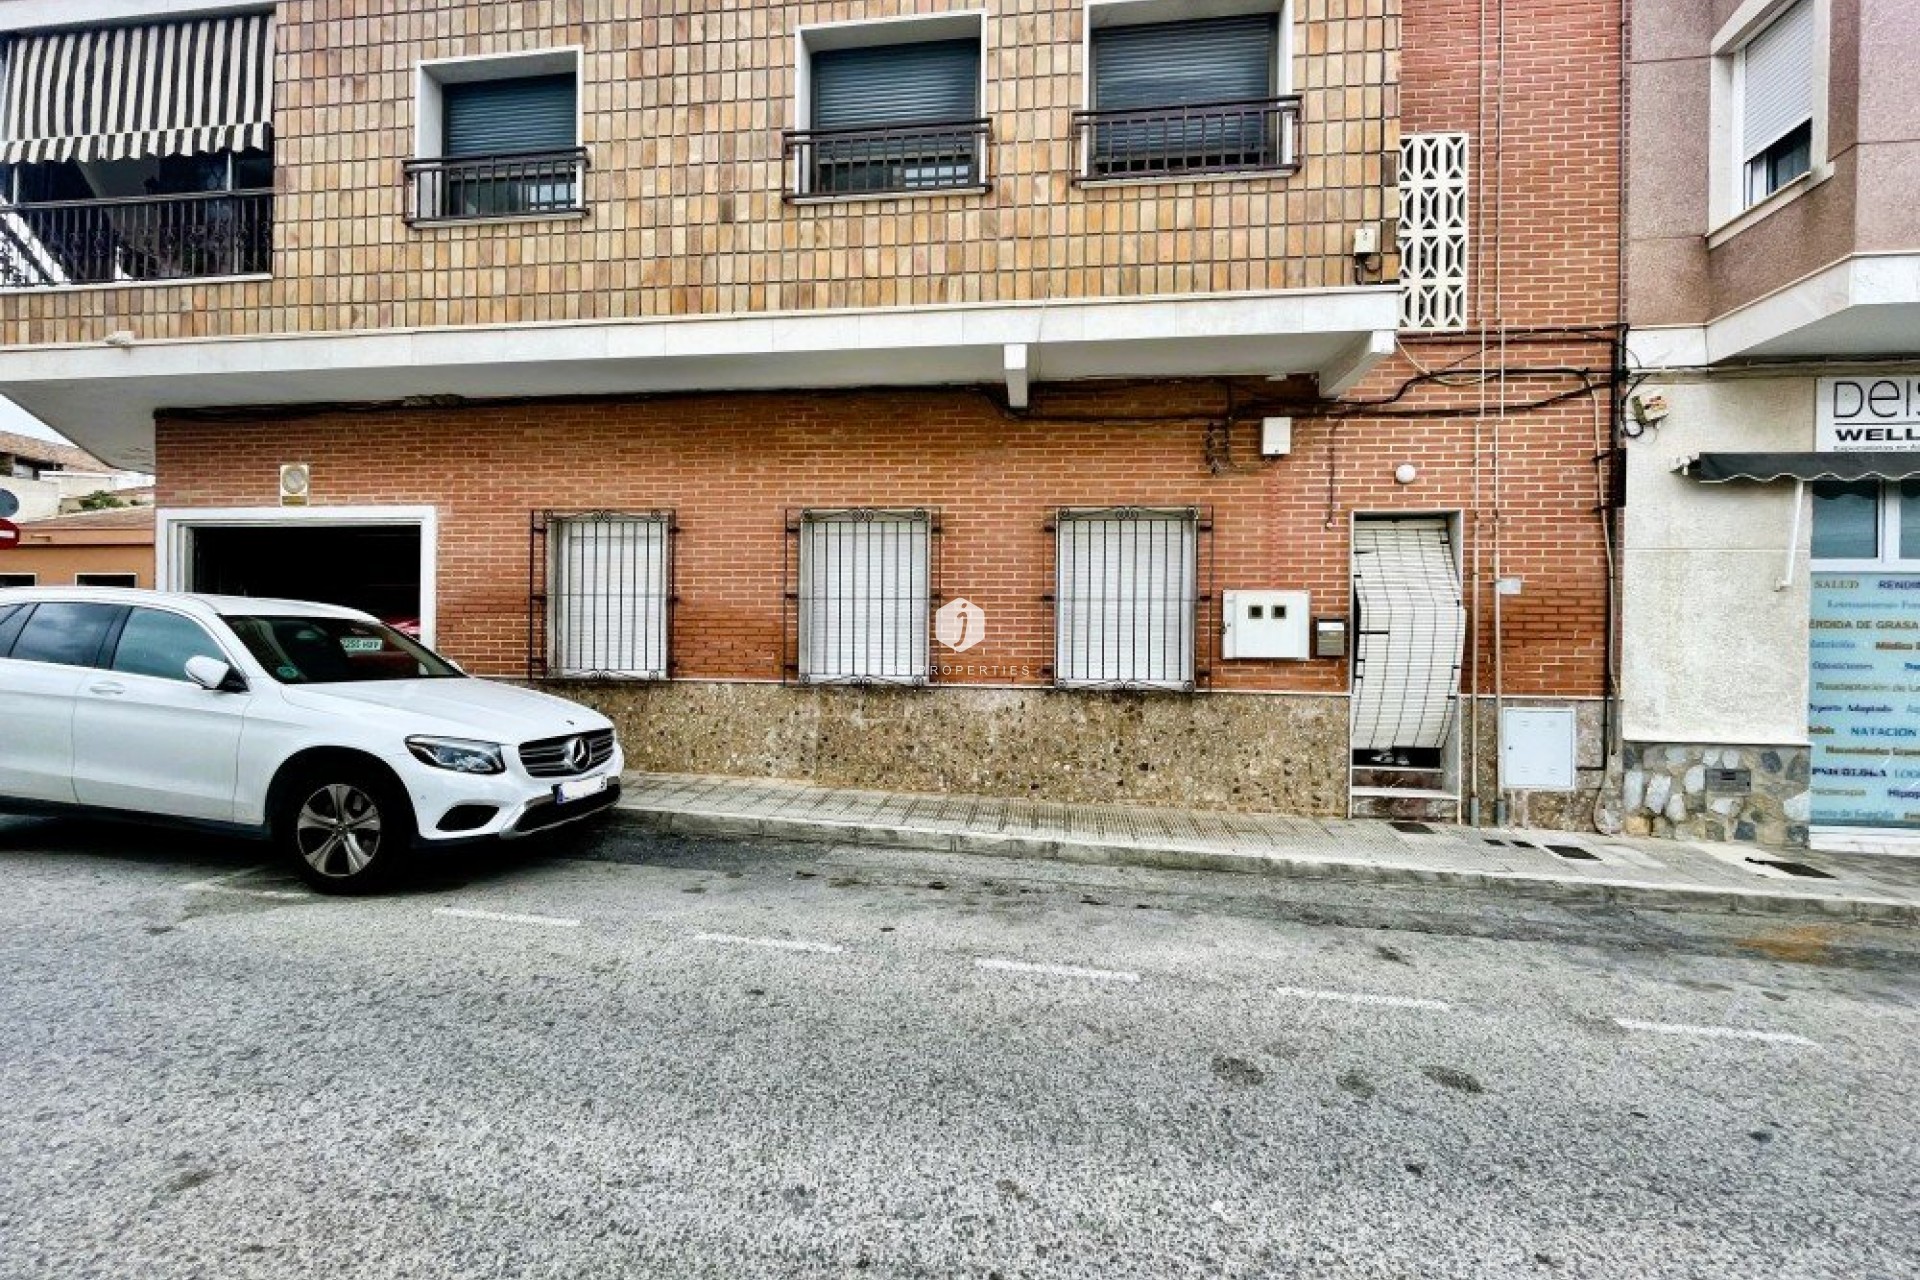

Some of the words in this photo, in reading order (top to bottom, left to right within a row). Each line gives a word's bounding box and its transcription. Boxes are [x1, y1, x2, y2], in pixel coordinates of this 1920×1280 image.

[1835, 428, 1920, 442] WELL
[1814, 580, 1859, 589] SALUD
[1856, 620, 1873, 629] DE
[1876, 620, 1919, 629] GRASA
